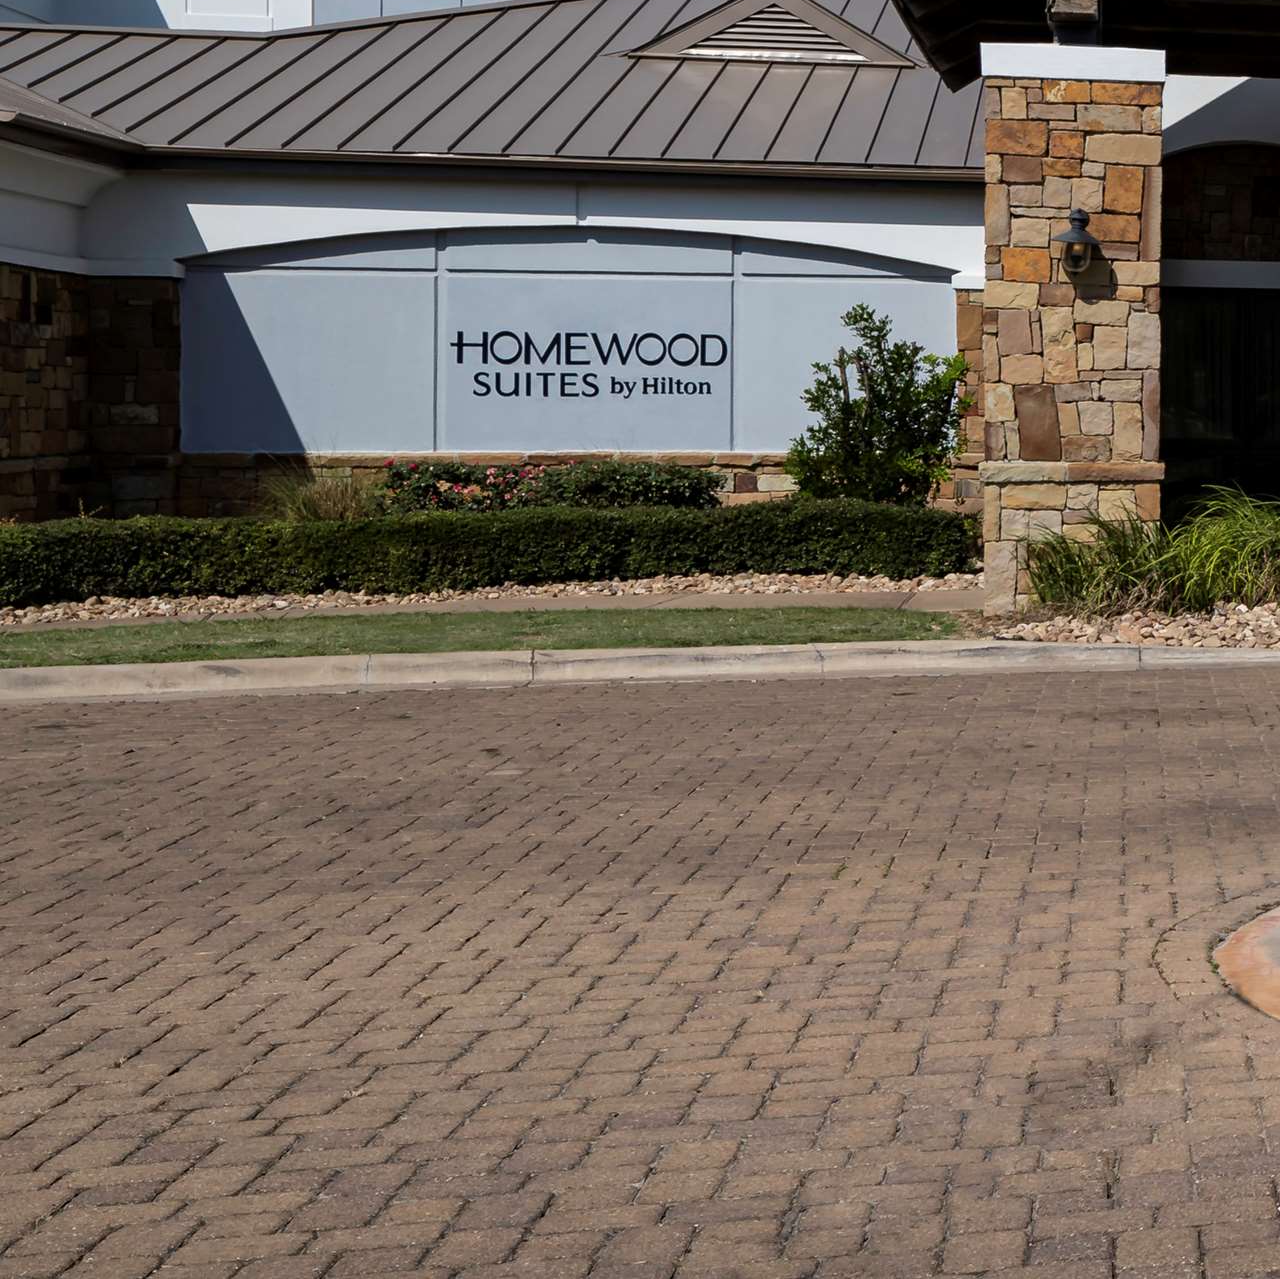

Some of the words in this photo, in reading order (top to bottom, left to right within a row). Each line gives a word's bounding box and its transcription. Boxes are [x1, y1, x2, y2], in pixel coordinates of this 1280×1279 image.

[450, 331, 728, 367] HOMEWOOD
[472, 372, 600, 397] SUITES
[609, 376, 636, 399] by
[641, 376, 712, 395] Hilton
